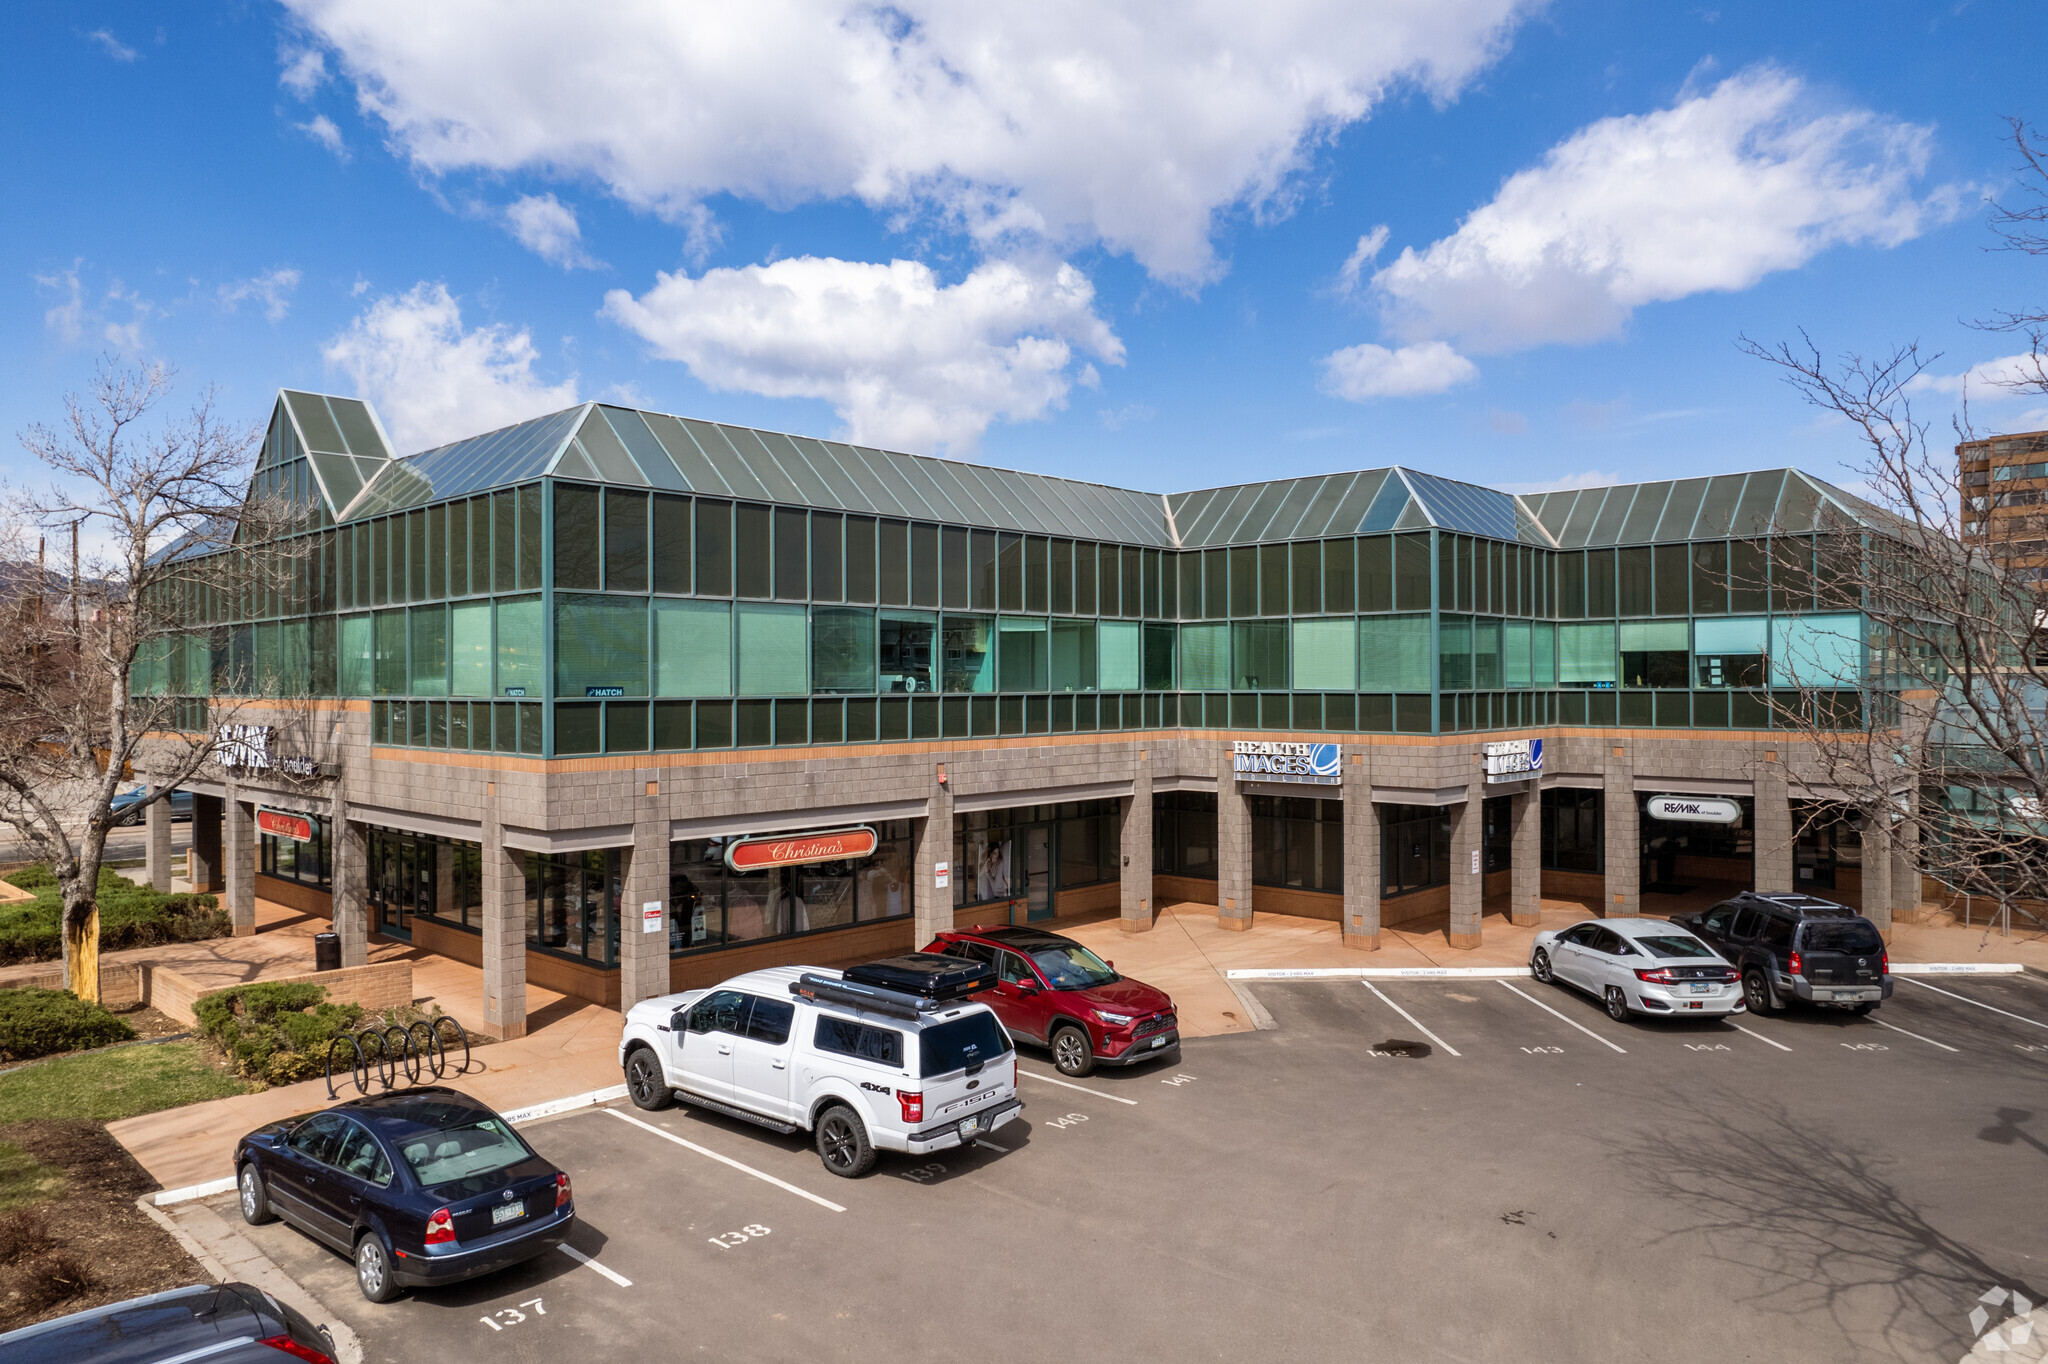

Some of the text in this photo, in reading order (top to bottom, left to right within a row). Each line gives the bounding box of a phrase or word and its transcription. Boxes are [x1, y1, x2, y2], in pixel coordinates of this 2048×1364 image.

[1233, 741, 1310, 755] HEALTH
[1234, 754, 1310, 774] IMAGES
[1237, 774, 1335, 784] BOULDER
[1664, 802, 1700, 814] RE/MAX
[768, 840, 843, 860] Christina's
[1520, 1046, 1564, 1054] 143
[1840, 1043, 1889, 1051] 145
[1161, 1073, 1198, 1086] 141
[944, 1091, 996, 1113] F-150
[516, 1111, 532, 1120] MAX
[1045, 1113, 1089, 1129] 140
[901, 1163, 947, 1181] 139
[708, 1224, 772, 1249] 138
[480, 1298, 547, 1331] 137
